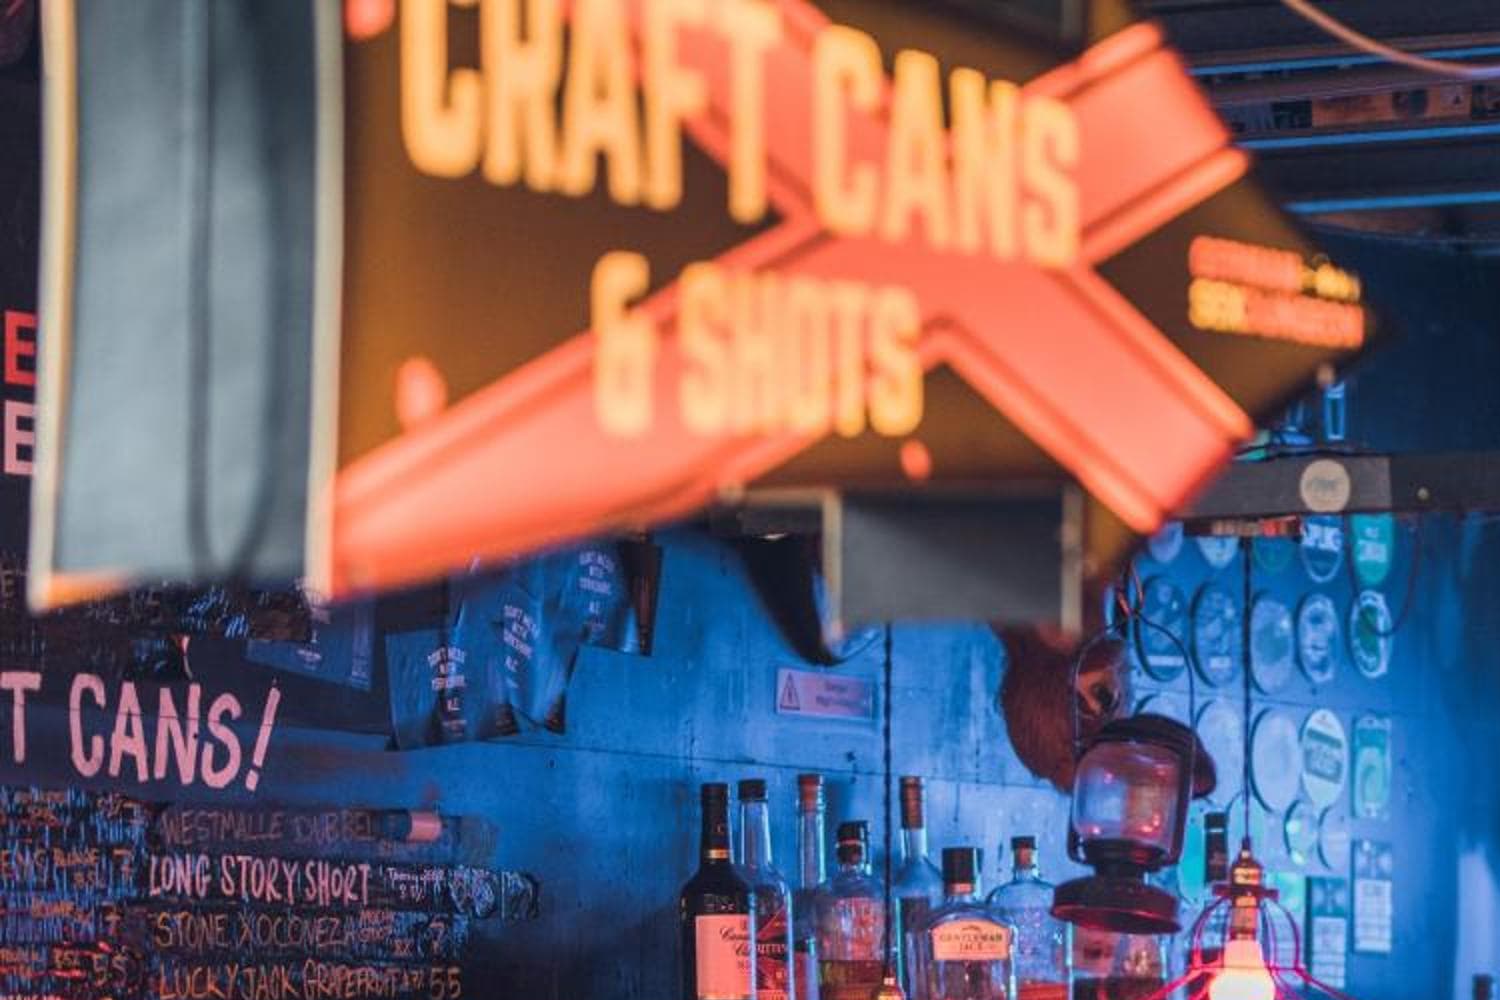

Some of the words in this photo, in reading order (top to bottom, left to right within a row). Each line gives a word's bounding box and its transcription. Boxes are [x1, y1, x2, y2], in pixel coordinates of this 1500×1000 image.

[401, 0, 779, 225] CRAFT
[812, 24, 1082, 268] CANS
[678, 260, 925, 438] SHOTS
[68, 672, 282, 792] CANS!
[150, 852, 212, 898] LONG
[220, 854, 299, 905] STORY
[304, 858, 371, 904] SHORT
[153, 909, 227, 949] STONE
